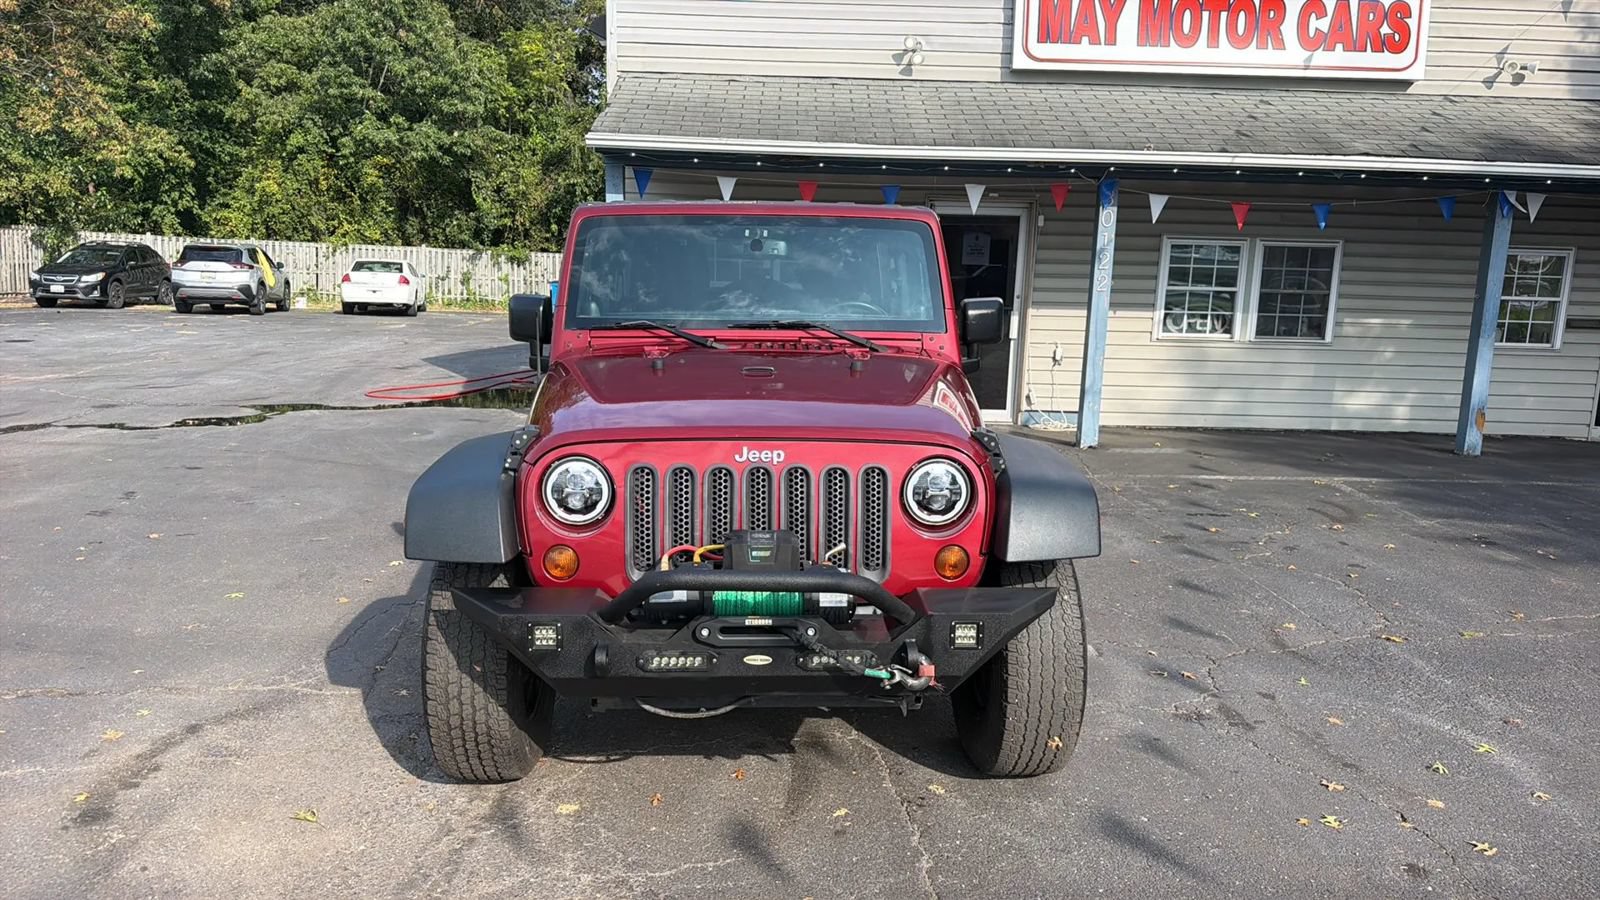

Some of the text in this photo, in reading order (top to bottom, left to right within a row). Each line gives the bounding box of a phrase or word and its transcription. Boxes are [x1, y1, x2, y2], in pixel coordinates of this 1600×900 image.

[1037, 0, 1412, 54] MAY MOTOR CARS
[734, 446, 785, 465] Jeep
